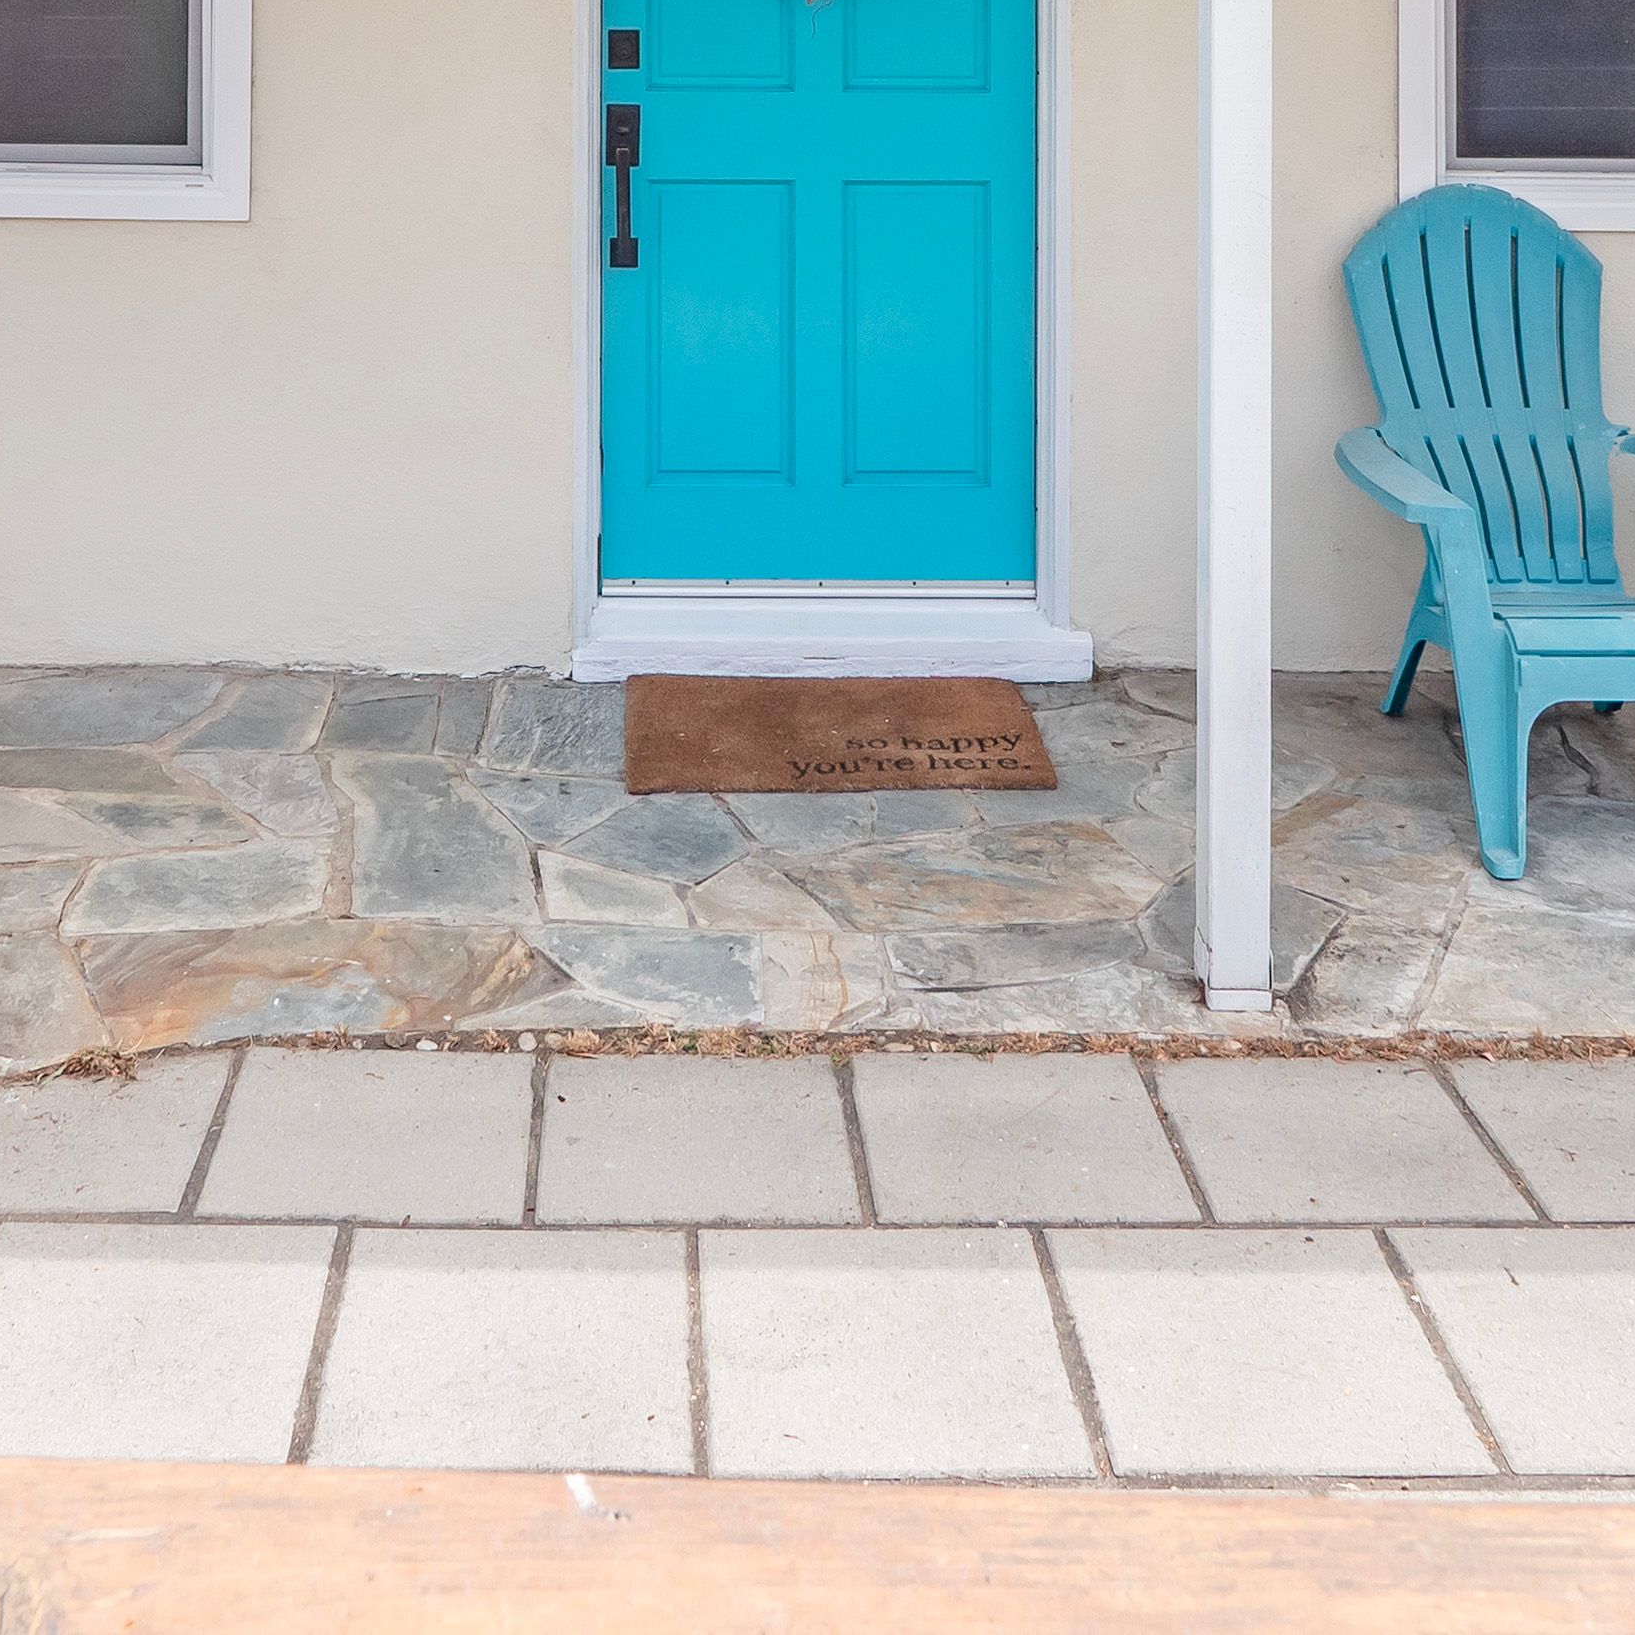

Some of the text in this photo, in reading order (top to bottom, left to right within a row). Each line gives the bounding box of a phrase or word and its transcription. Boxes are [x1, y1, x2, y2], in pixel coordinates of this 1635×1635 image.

[845, 732, 1023, 754] so happy
[786, 754, 1032, 780] you're here.
